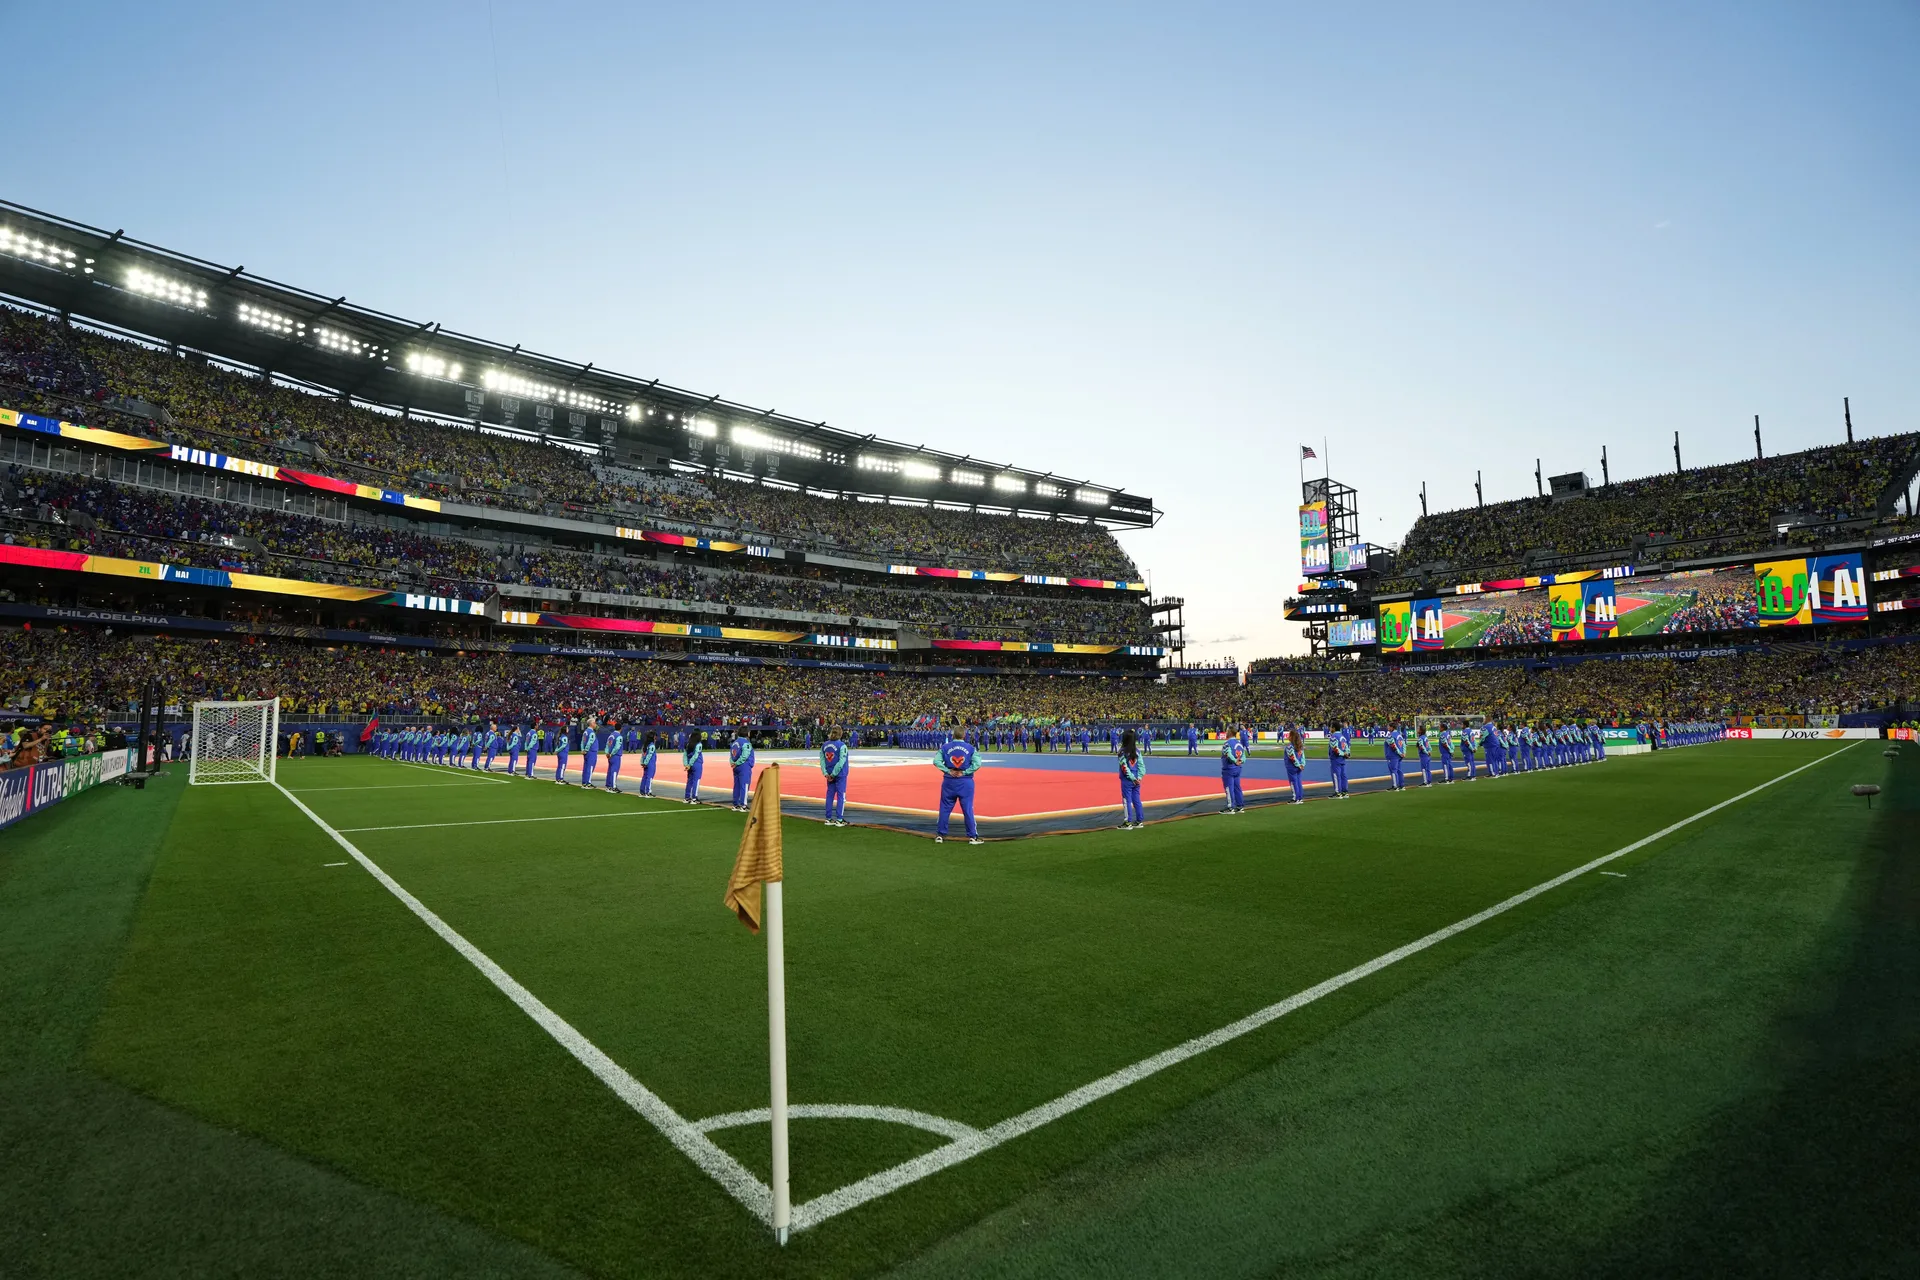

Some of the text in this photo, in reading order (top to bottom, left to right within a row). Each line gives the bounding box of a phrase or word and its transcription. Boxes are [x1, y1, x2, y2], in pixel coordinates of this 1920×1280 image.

[46, 608, 169, 625] PHILADELPHIA
[1404, 664, 1431, 673] WORLD
[1782, 728, 1819, 739] Dove
[34, 766, 63, 808] ULTRA
